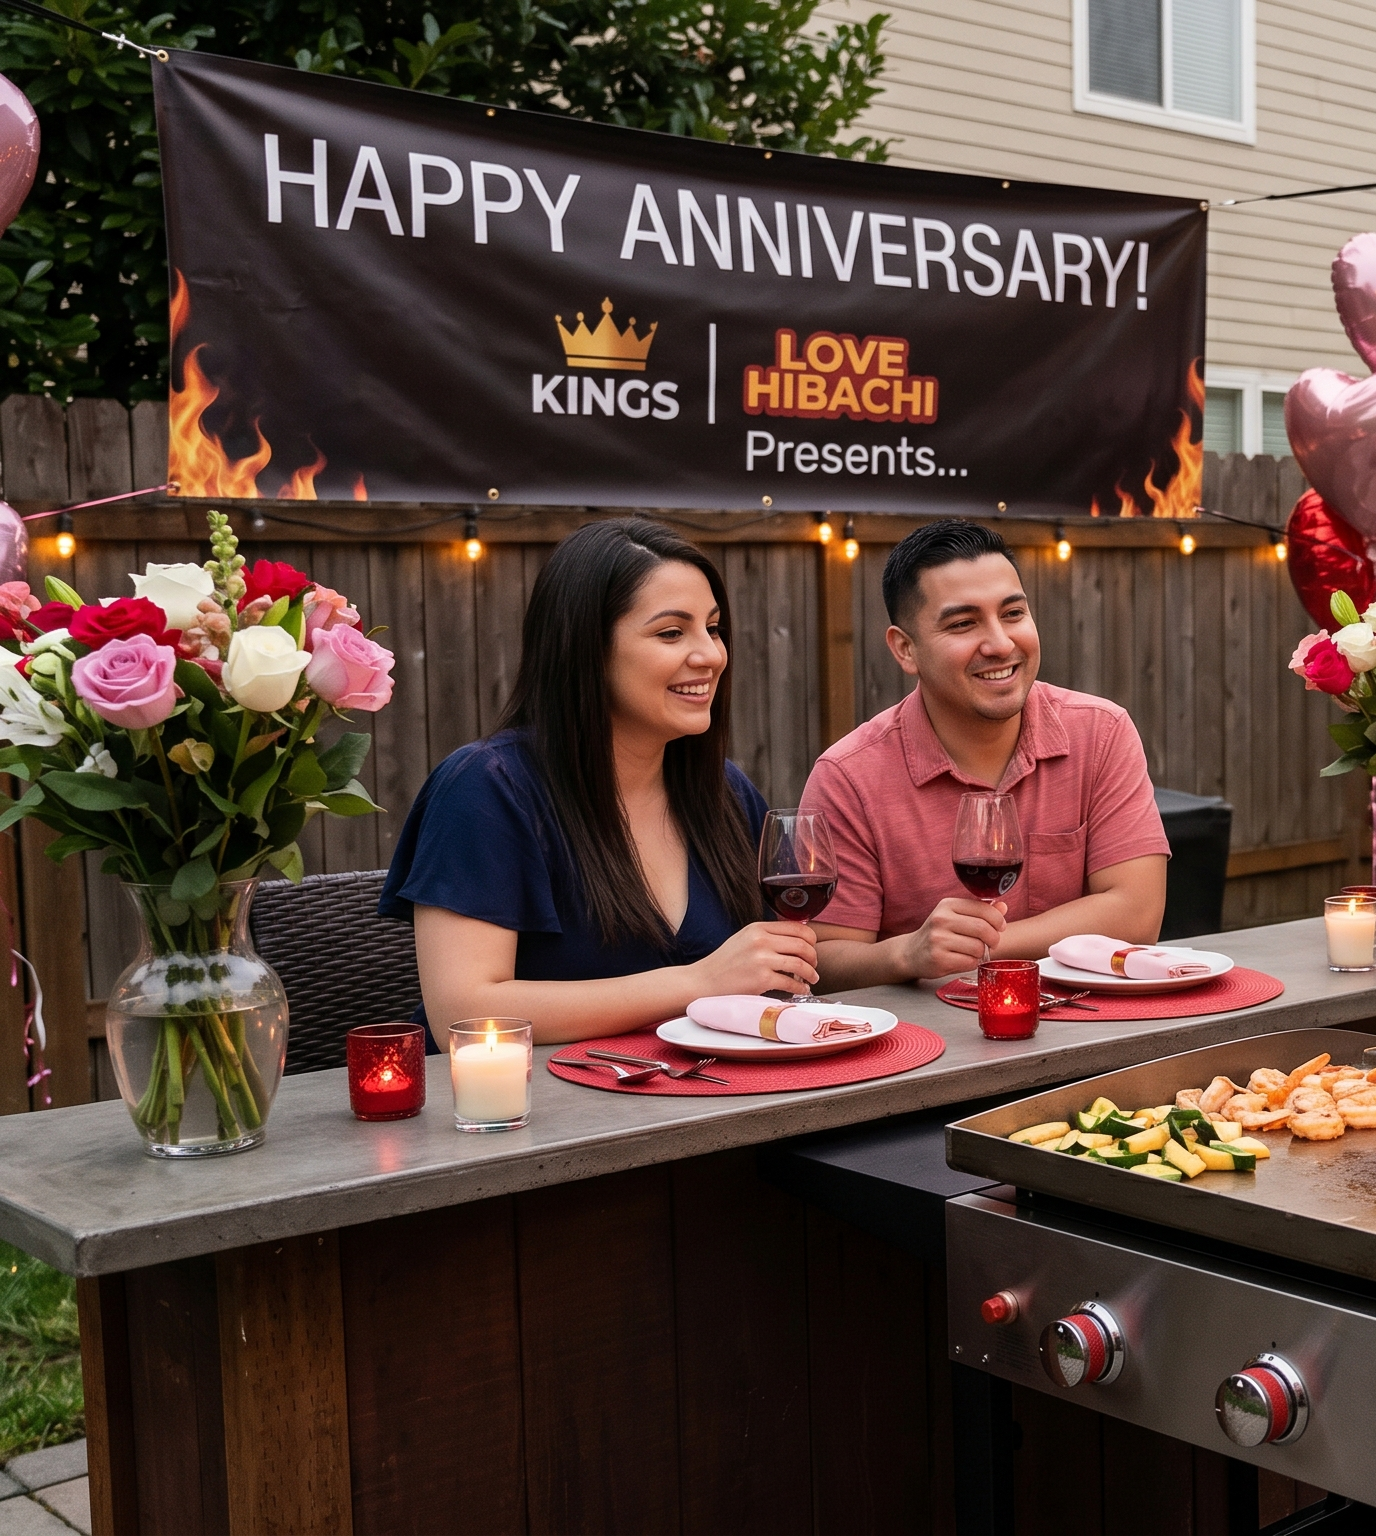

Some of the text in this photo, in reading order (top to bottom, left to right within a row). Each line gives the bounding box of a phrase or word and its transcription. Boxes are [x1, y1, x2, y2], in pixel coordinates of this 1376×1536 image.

[264, 133, 1149, 311] HAPPY ANNIVERSARY!
[779, 333, 905, 377] LOVE
[532, 373, 680, 420] KINGS
[748, 370, 934, 417] HIBACHI
[746, 430, 968, 477] Presents...
